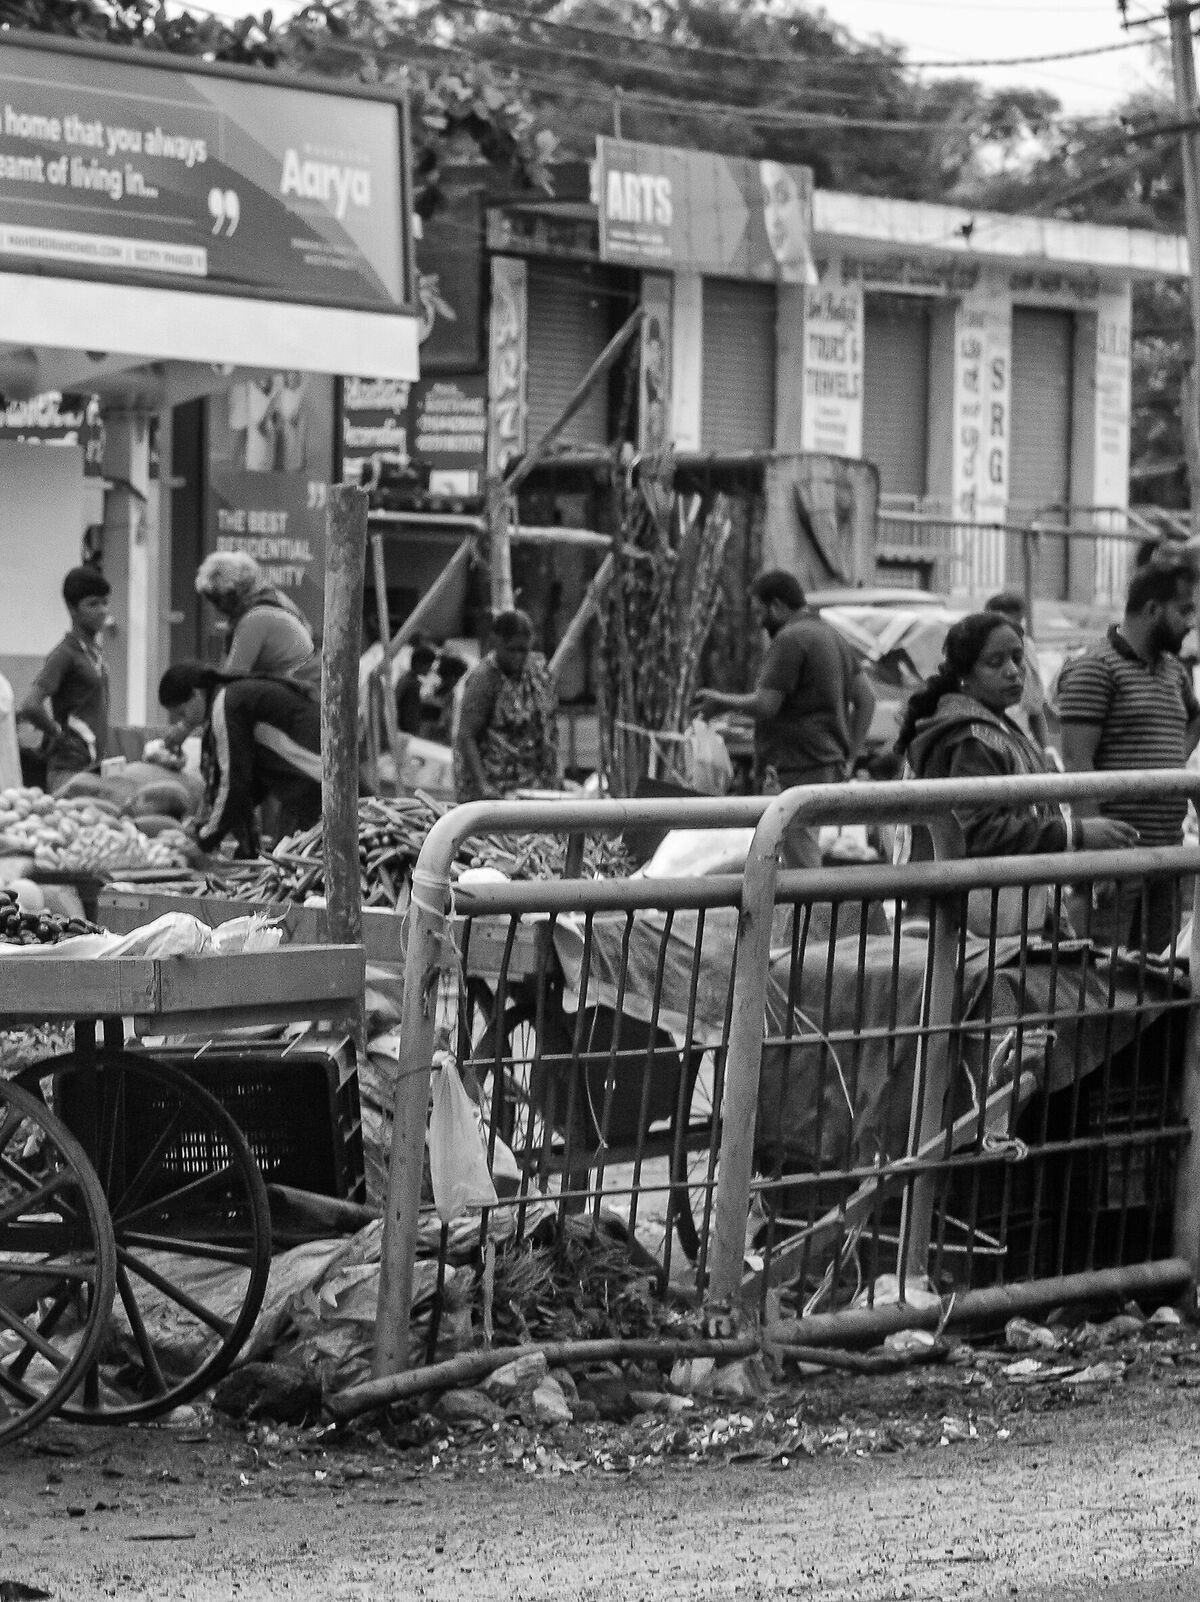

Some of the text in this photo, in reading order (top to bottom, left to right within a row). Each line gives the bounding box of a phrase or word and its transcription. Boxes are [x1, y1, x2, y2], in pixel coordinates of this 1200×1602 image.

[4, 103, 61, 142] home
[63, 113, 104, 148] that
[106, 126, 143, 157] you
[145, 126, 208, 168] always
[47, 155, 68, 186] of
[70, 155, 123, 201] living
[125, 163, 159, 199] in...
[280, 148, 371, 220] Aarya
[608, 170, 673, 227] ARTS
[809, 333, 847, 363] TOURS
[807, 368, 859, 399] TRAVELS
[218, 508, 289, 534] THE BEST
